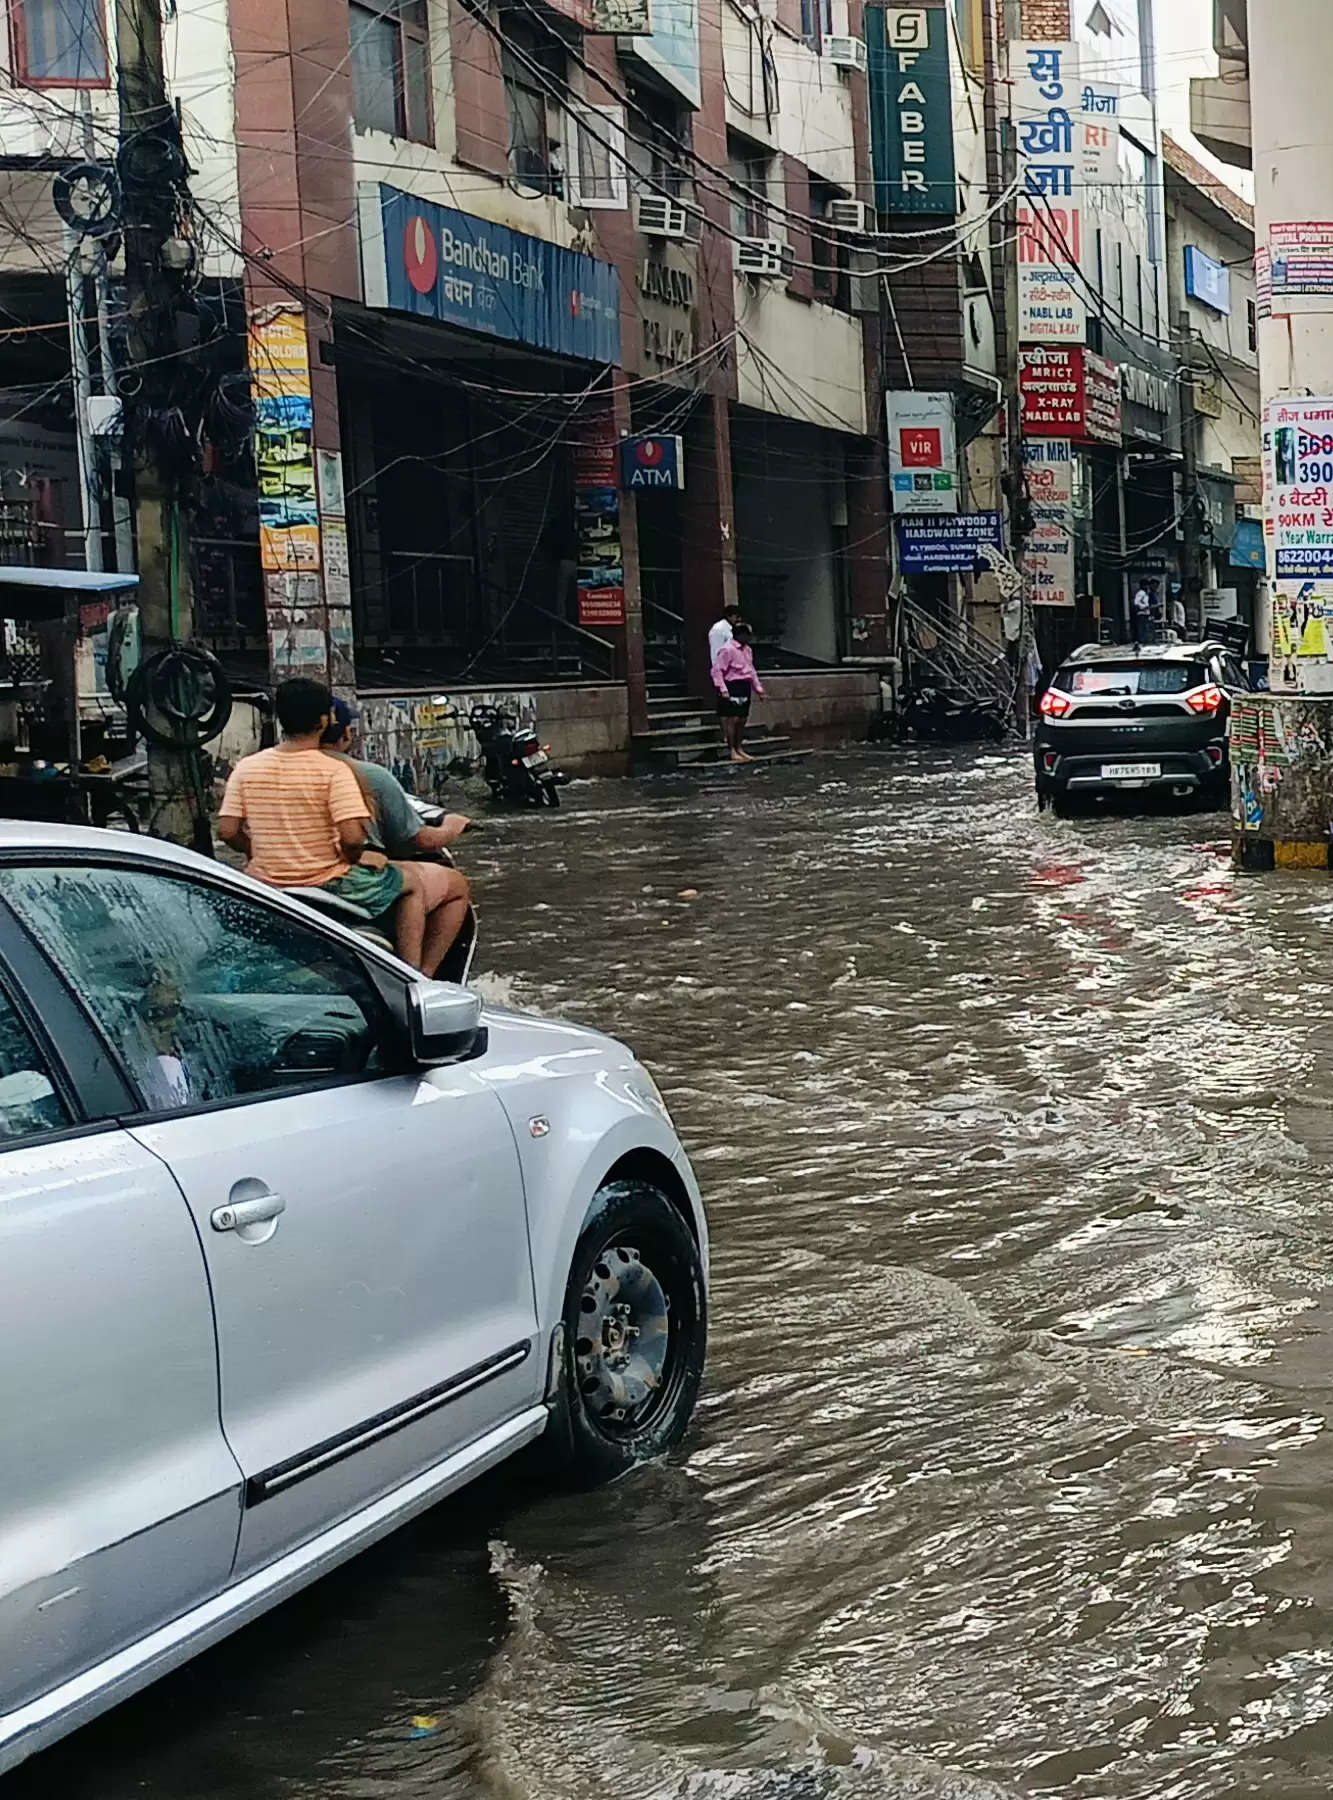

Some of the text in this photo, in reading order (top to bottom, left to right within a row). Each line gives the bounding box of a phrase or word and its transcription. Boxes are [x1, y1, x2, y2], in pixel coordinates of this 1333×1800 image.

[897, 51, 929, 193] FABER
[1019, 208, 1081, 264] MRI
[442, 227, 545, 292] Bandhan Bank
[1029, 309, 1073, 319] NABL LAB
[1037, 397, 1074, 408] X-RAY
[1057, 412, 1081, 422] LAB
[630, 468, 672, 486] ATM
[1278, 513, 1316, 528] 90KM
